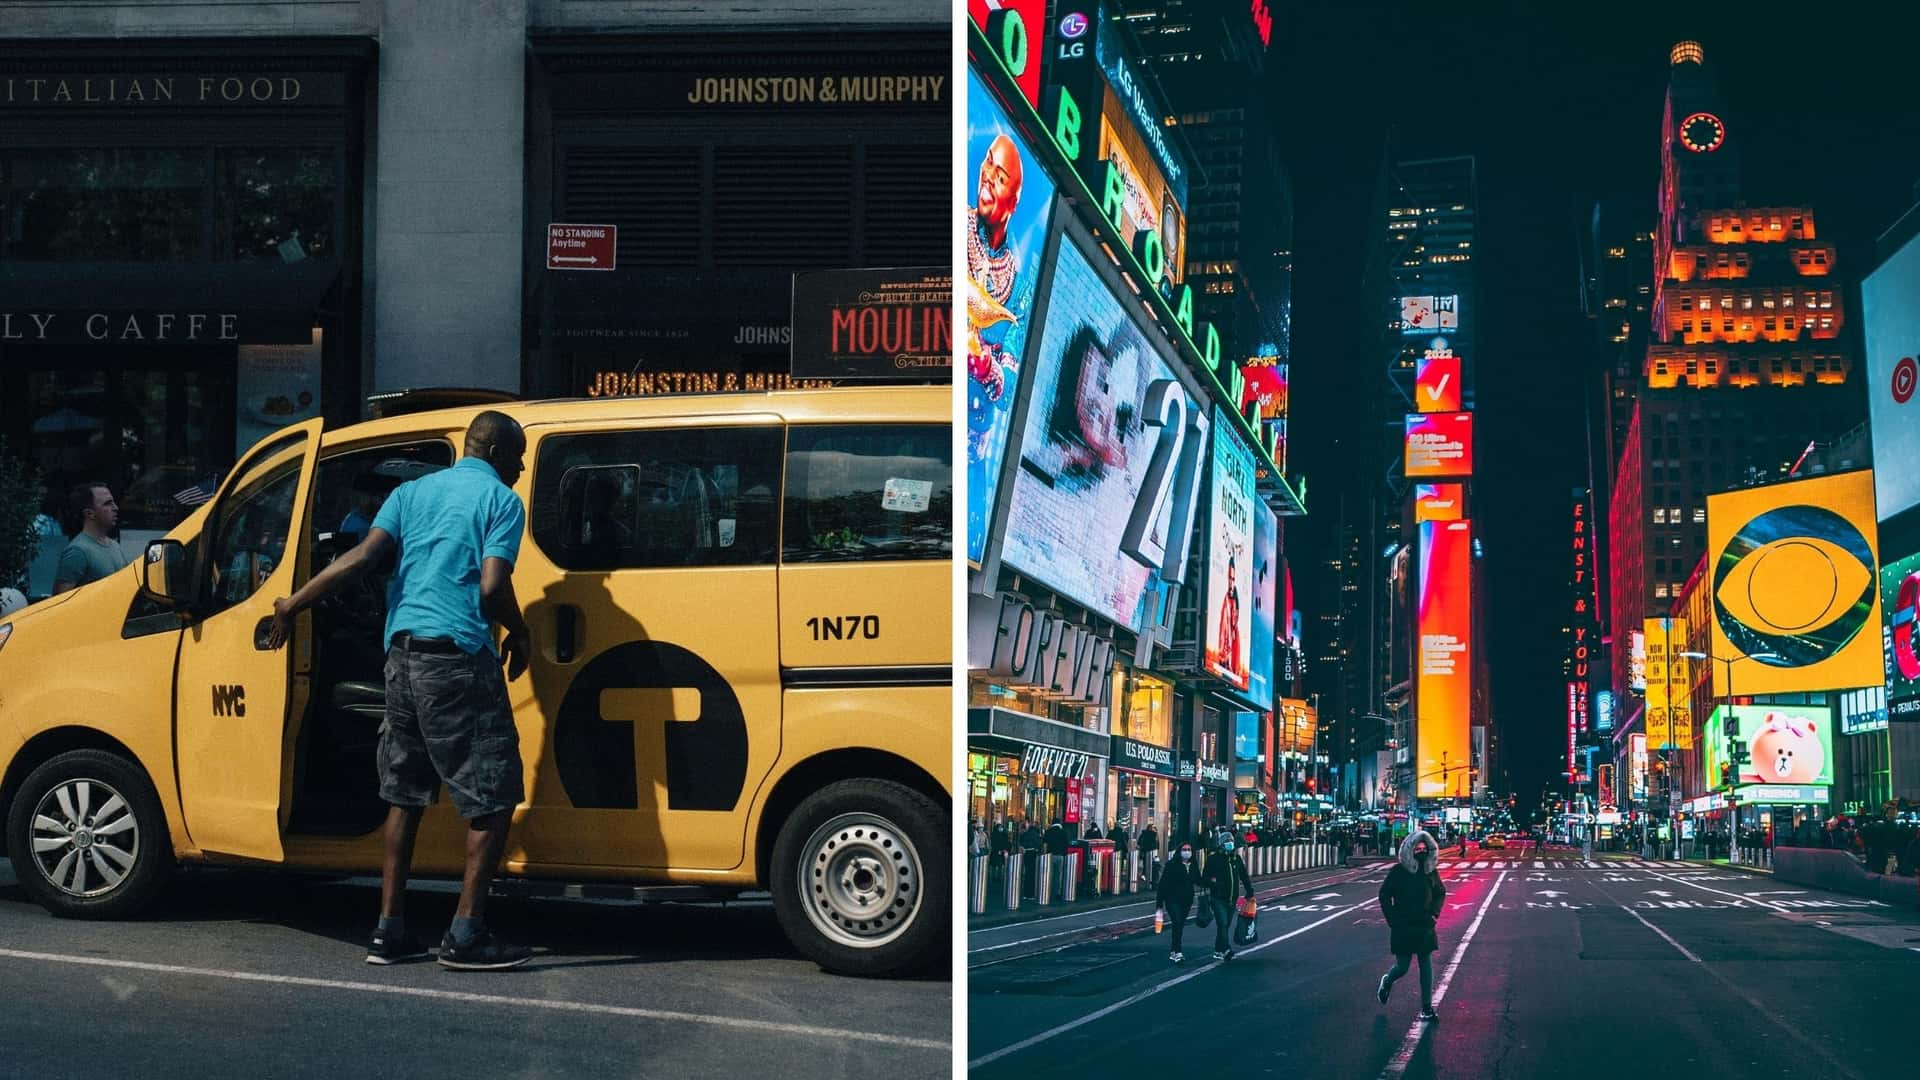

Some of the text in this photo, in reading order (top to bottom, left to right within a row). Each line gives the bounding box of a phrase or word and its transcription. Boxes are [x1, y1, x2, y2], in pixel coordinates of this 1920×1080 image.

[1059, 42, 1085, 59] LG
[7, 77, 302, 102] ITALIAN FOOD
[1116, 56, 1133, 97] LG
[552, 228, 606, 239] NO STANDING
[552, 239, 586, 249] Anytime
[86, 313, 239, 341] CAFFE
[831, 306, 953, 353] MOULIN
[1424, 348, 1453, 359] 2022
[587, 371, 718, 397] JOHNSTON
[723, 372, 740, 391] &
[1221, 484, 1247, 536] NORTH
[1573, 503, 1585, 583] ERNST
[1575, 599, 1586, 613] &
[805, 614, 880, 641] 1N70
[985, 592, 1117, 708] FOREVER
[211, 684, 247, 718] NYC
[1022, 744, 1089, 781] FOREVER 21
[1137, 746, 1154, 762] POLO
